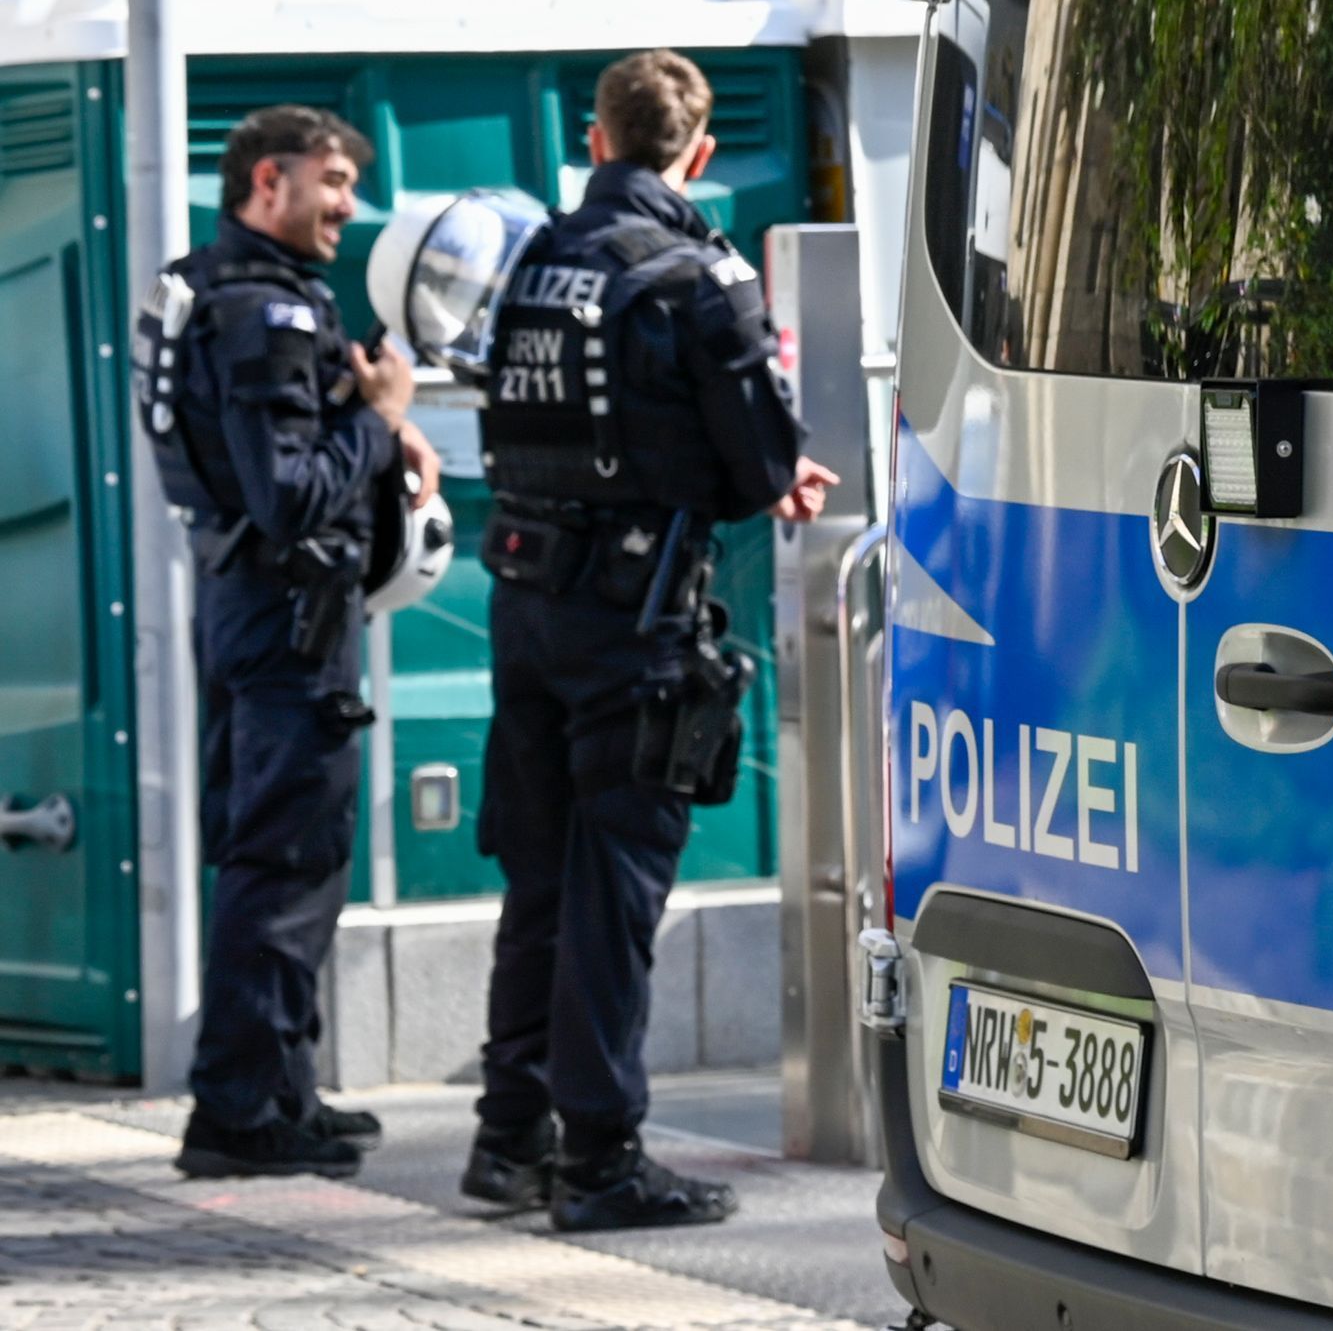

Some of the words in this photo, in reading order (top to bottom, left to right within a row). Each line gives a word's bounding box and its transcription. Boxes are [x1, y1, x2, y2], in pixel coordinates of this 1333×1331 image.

[506, 264, 607, 307] LIZEI
[500, 366, 566, 402] 2711
[911, 700, 1139, 873] POLIZEI
[1027, 1018, 1136, 1123] 5-3888
